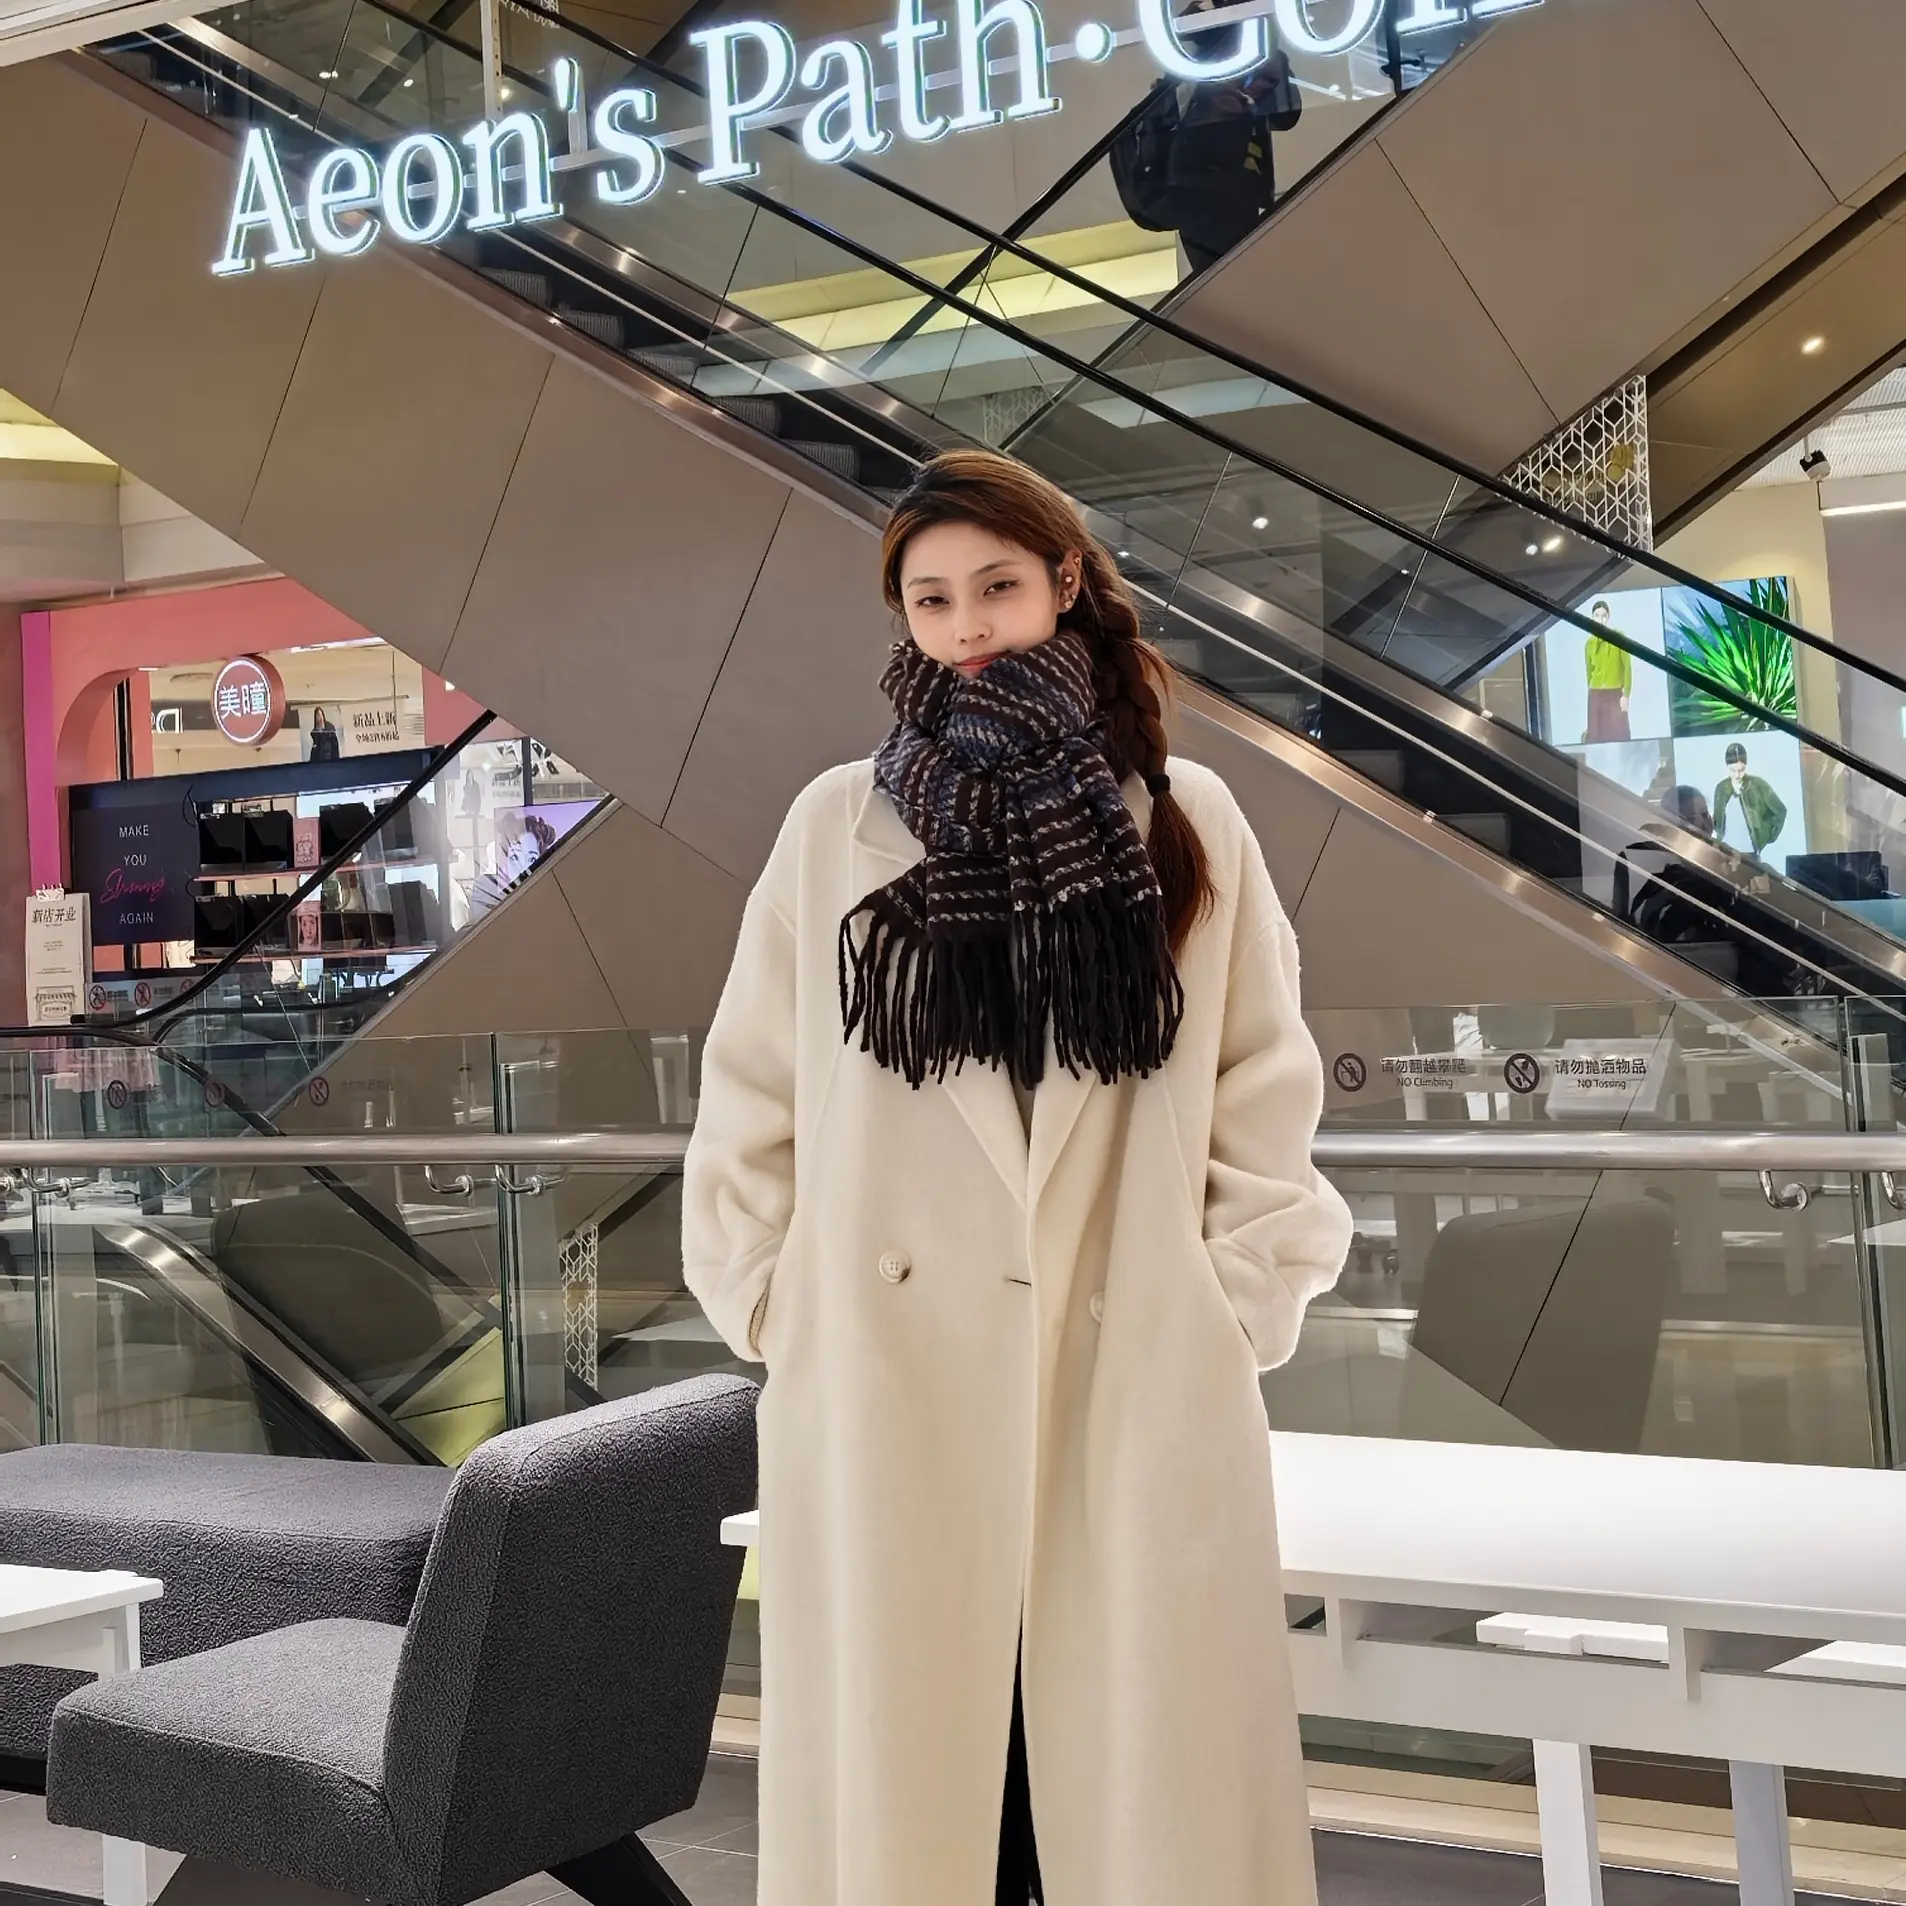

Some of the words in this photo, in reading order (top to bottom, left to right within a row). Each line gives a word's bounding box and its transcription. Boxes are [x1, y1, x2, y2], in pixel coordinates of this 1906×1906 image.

[212, 57, 665, 276] Aeon's
[218, 680, 269, 720] 美瞳
[119, 825, 149, 838] MAKE
[124, 854, 147, 866] YOU
[119, 912, 154, 924] AGAIN
[1554, 1058, 1647, 1075] 请勿抛洒物品
[1397, 1077, 1412, 1087] NO
[1577, 1079, 1592, 1089] NO
[1593, 1078, 1627, 1091] Tossing
